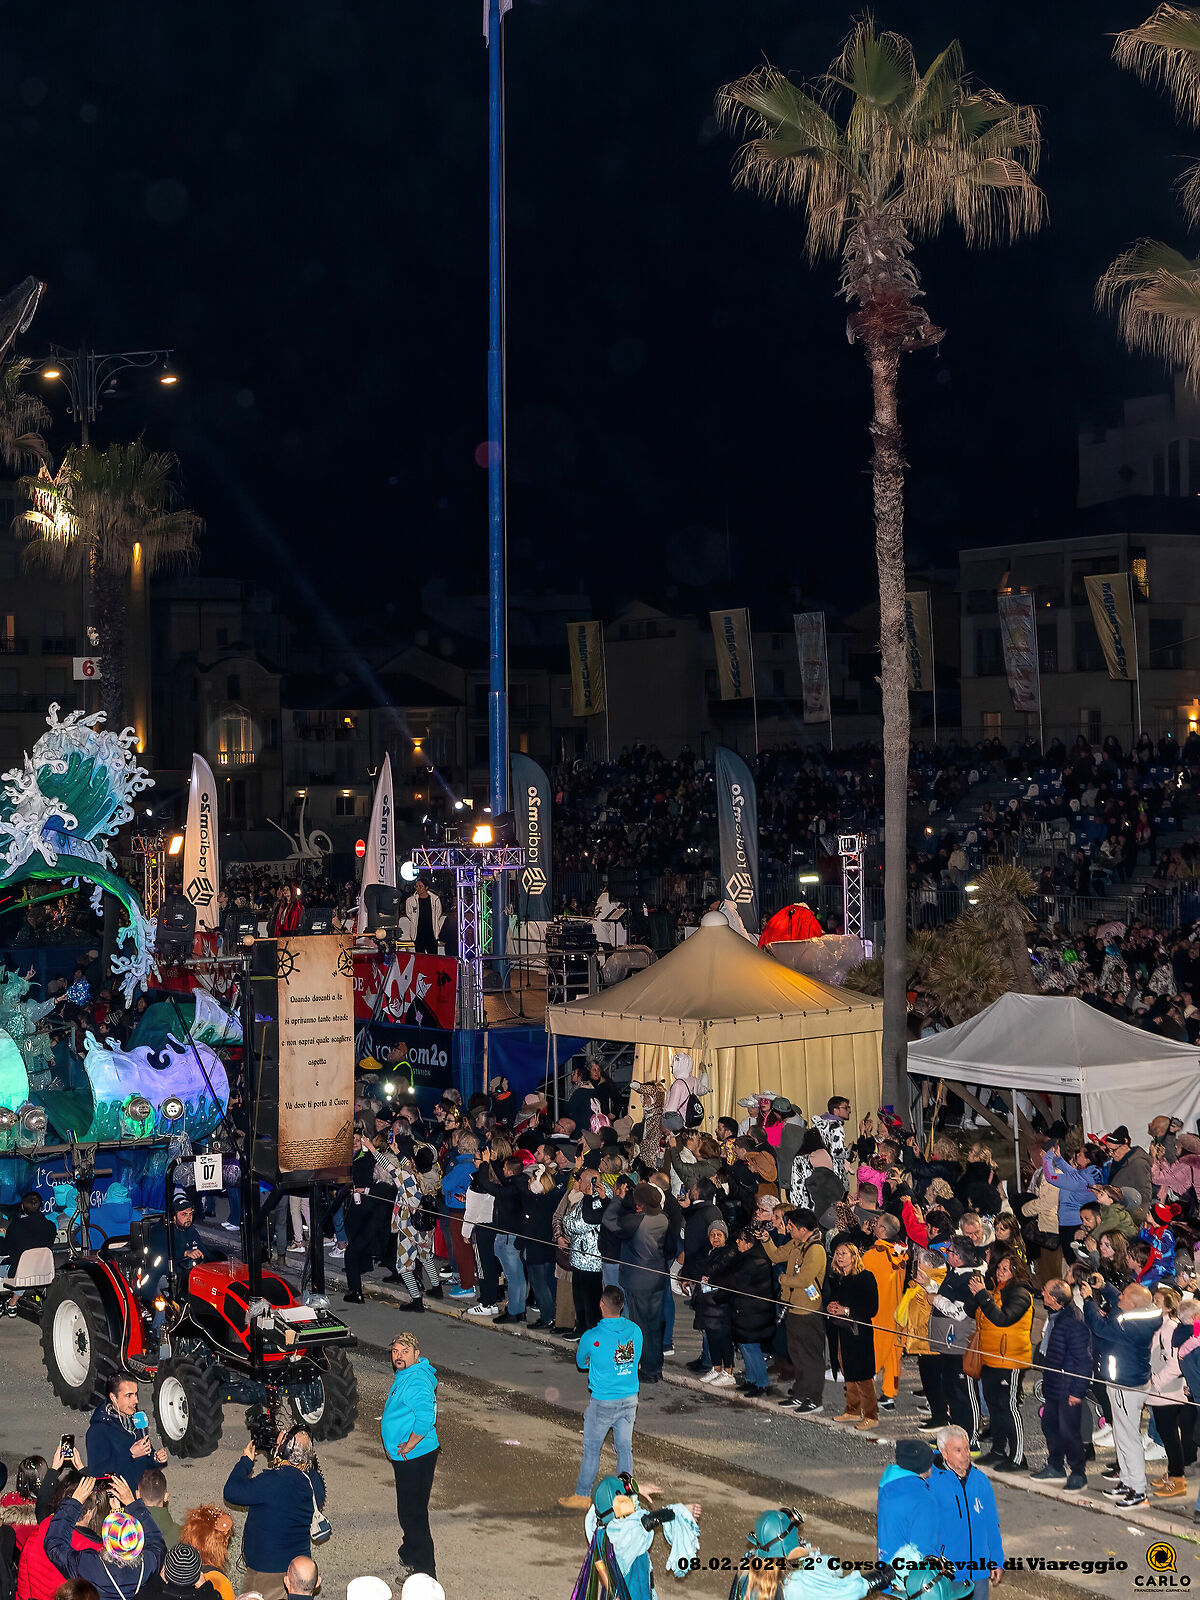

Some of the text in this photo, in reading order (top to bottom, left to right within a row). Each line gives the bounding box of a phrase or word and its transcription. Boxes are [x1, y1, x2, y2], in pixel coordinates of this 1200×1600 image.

[82, 659, 95, 676] 6
[376, 1043, 448, 1067] raom2o
[203, 1165, 215, 1180] 07
